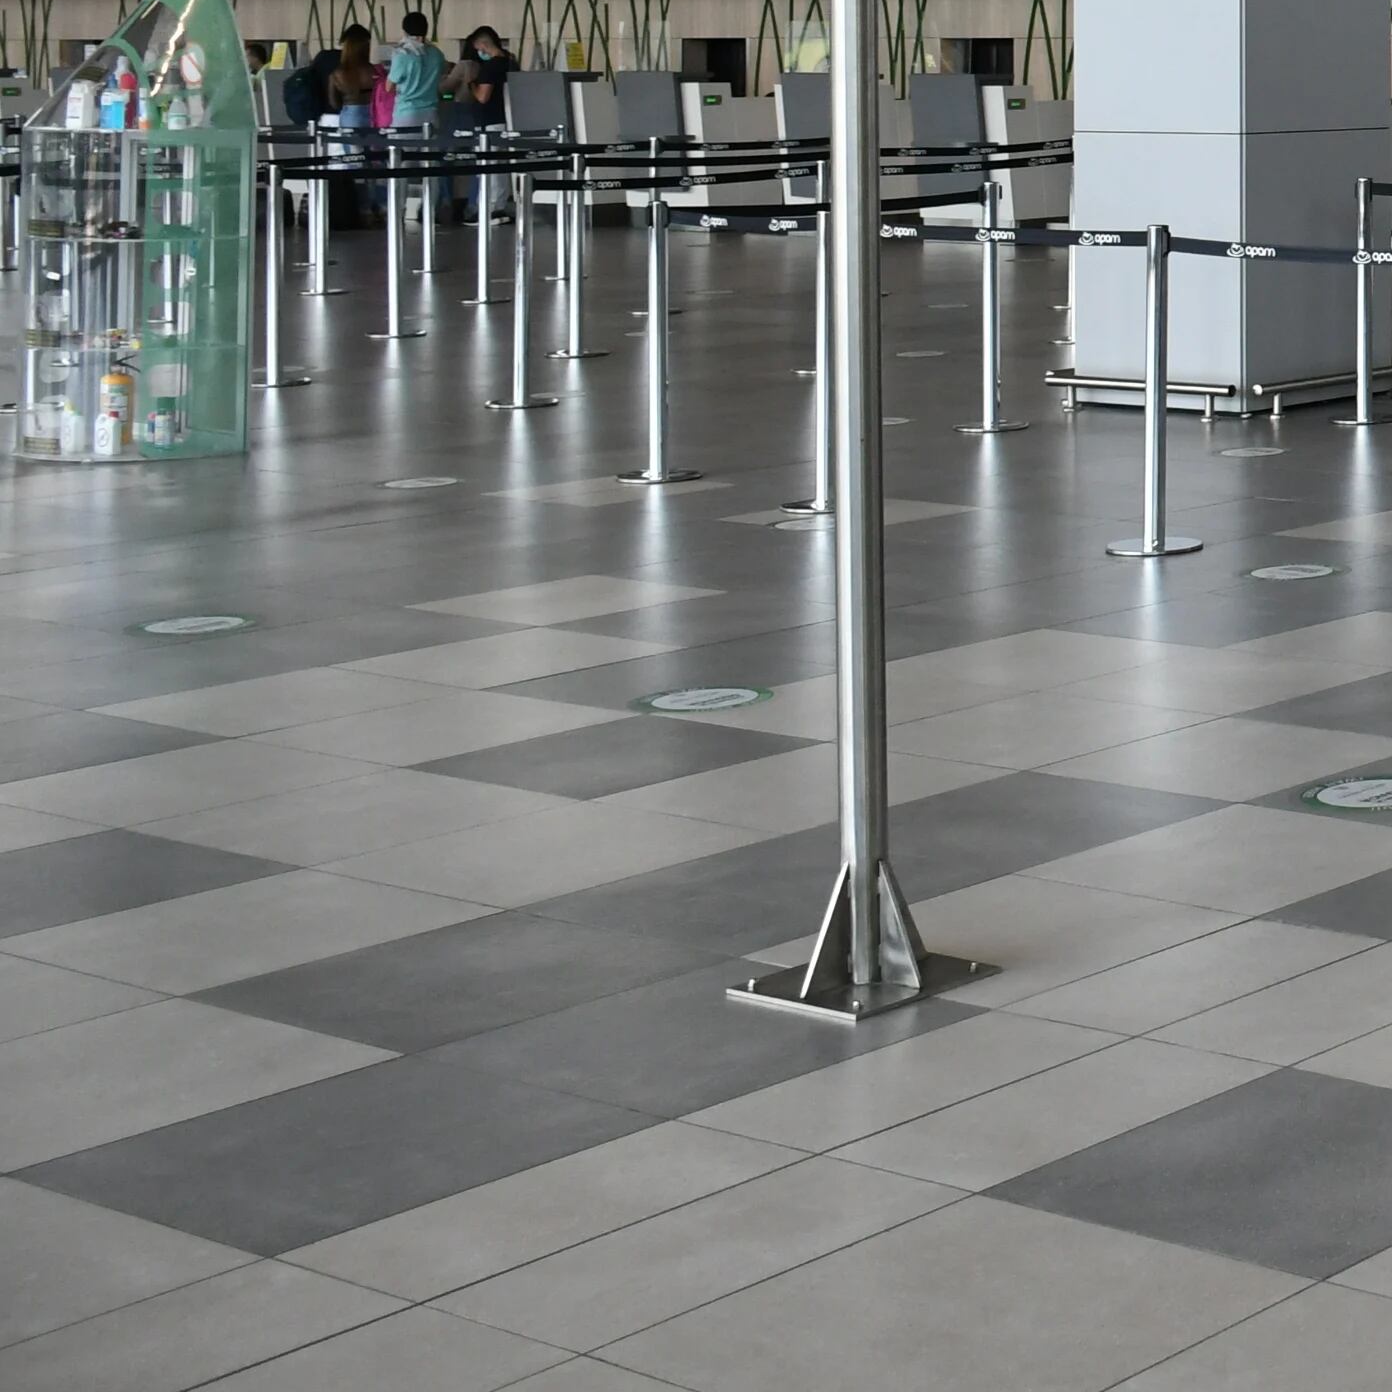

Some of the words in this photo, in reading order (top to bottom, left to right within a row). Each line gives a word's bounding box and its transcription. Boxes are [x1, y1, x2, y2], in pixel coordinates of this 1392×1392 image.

[990, 229, 1015, 242] opam
[1094, 231, 1121, 244] opam
[1245, 246, 1276, 258] opam
